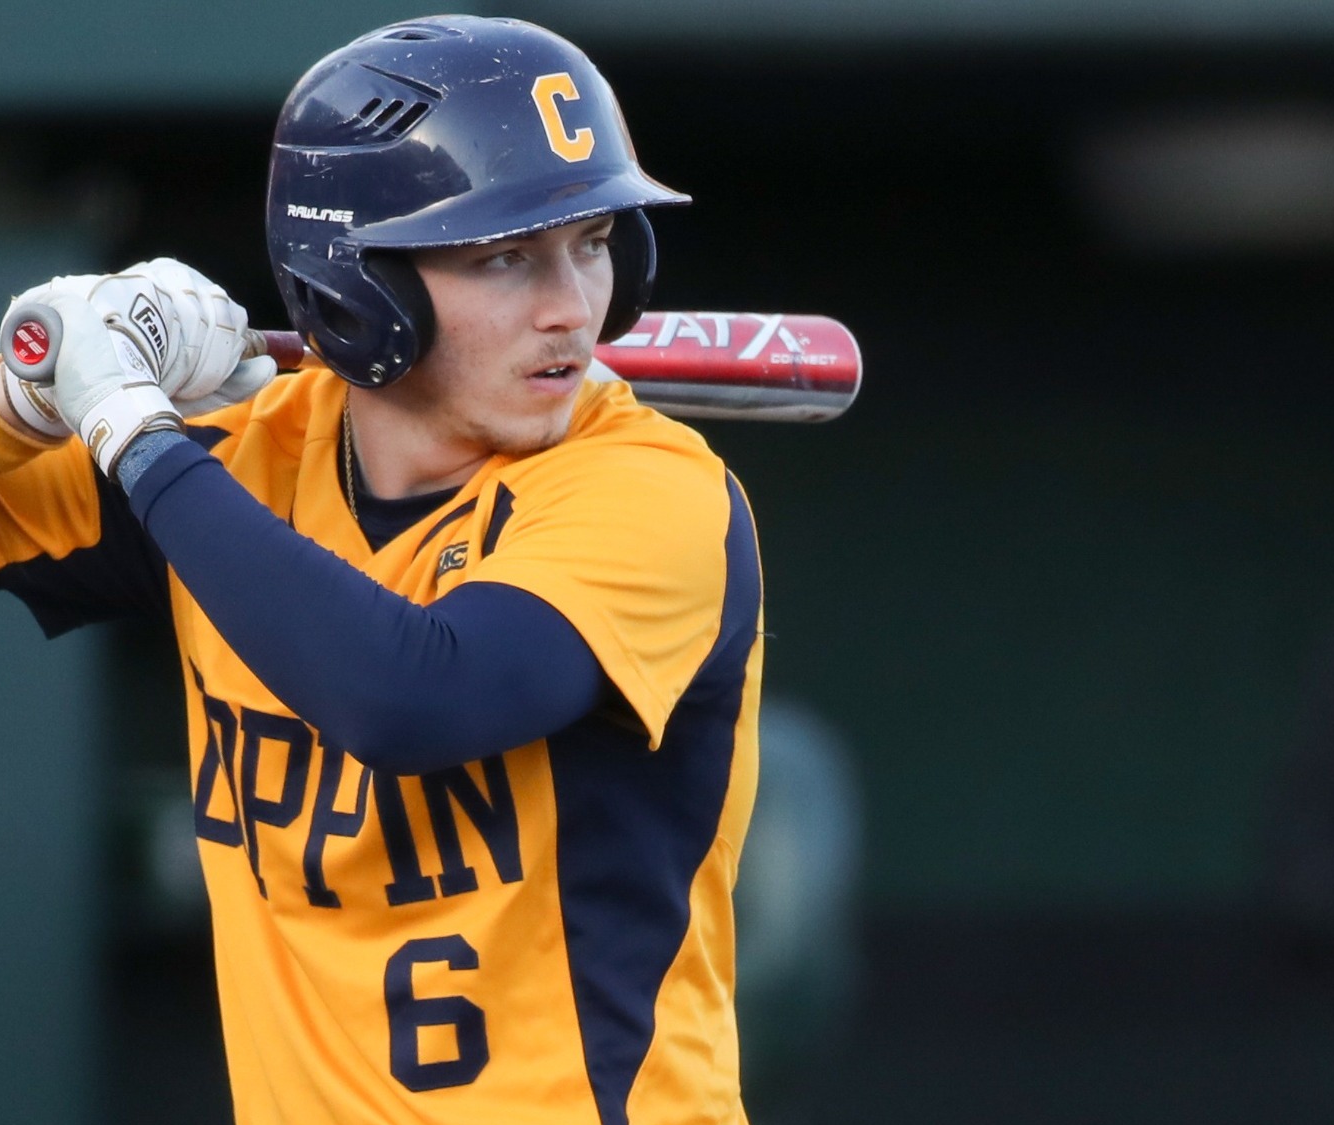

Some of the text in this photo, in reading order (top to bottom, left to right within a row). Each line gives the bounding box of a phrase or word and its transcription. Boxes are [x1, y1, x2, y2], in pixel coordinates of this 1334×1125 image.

[531, 72, 595, 163] C
[287, 204, 354, 223] RAWLINGS
[770, 353, 838, 366] CONNECT
[189, 655, 524, 909] OPPIN
[384, 934, 490, 1092] 6
